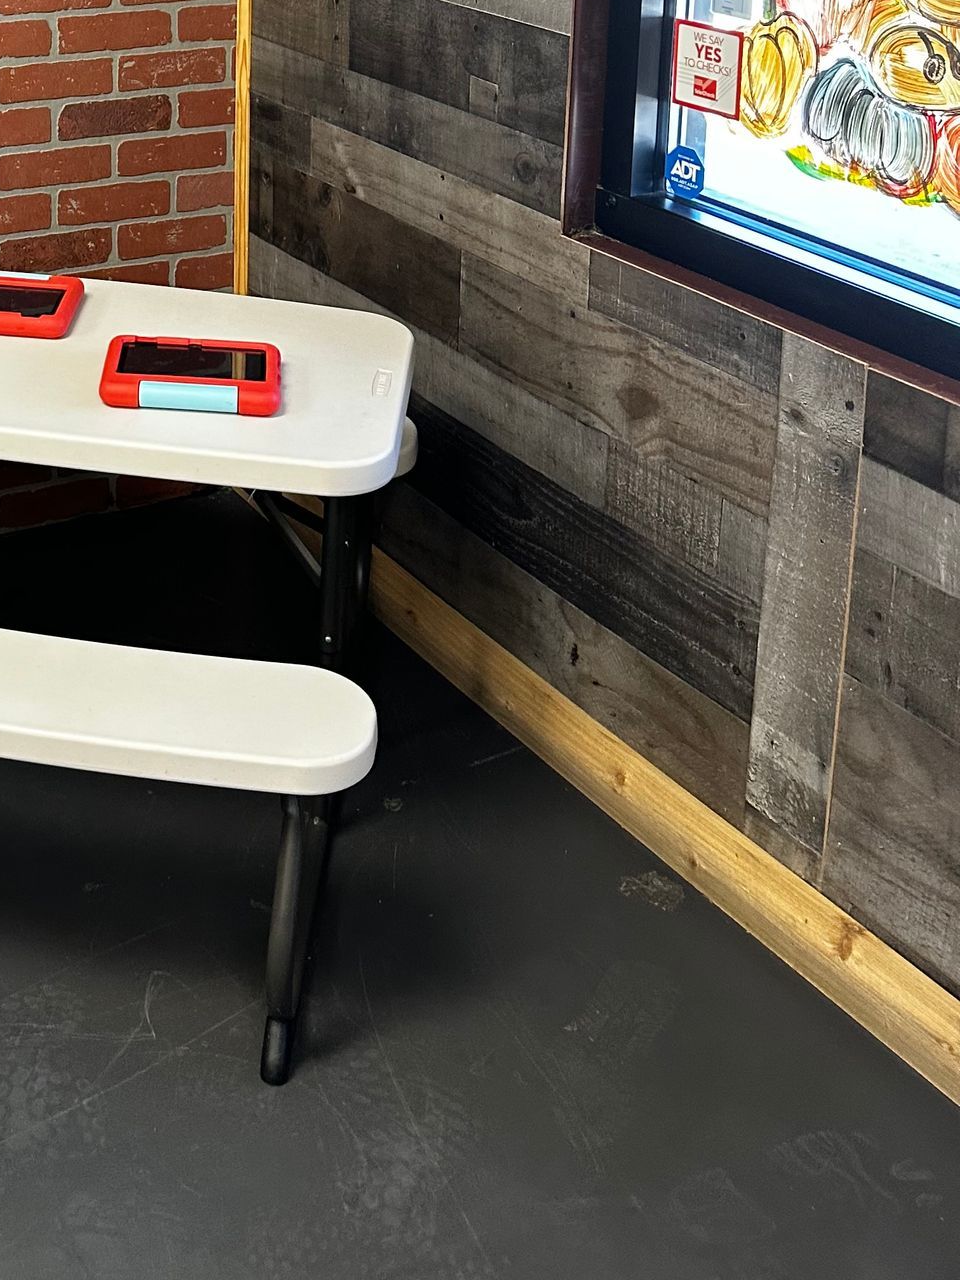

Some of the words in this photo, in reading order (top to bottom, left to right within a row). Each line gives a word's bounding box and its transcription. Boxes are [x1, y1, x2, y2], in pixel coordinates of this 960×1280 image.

[693, 31, 708, 44] WE
[708, 34, 724, 47] SAY
[695, 42, 722, 63] YES
[684, 56, 696, 68] TO
[670, 159, 701, 183] ADT
